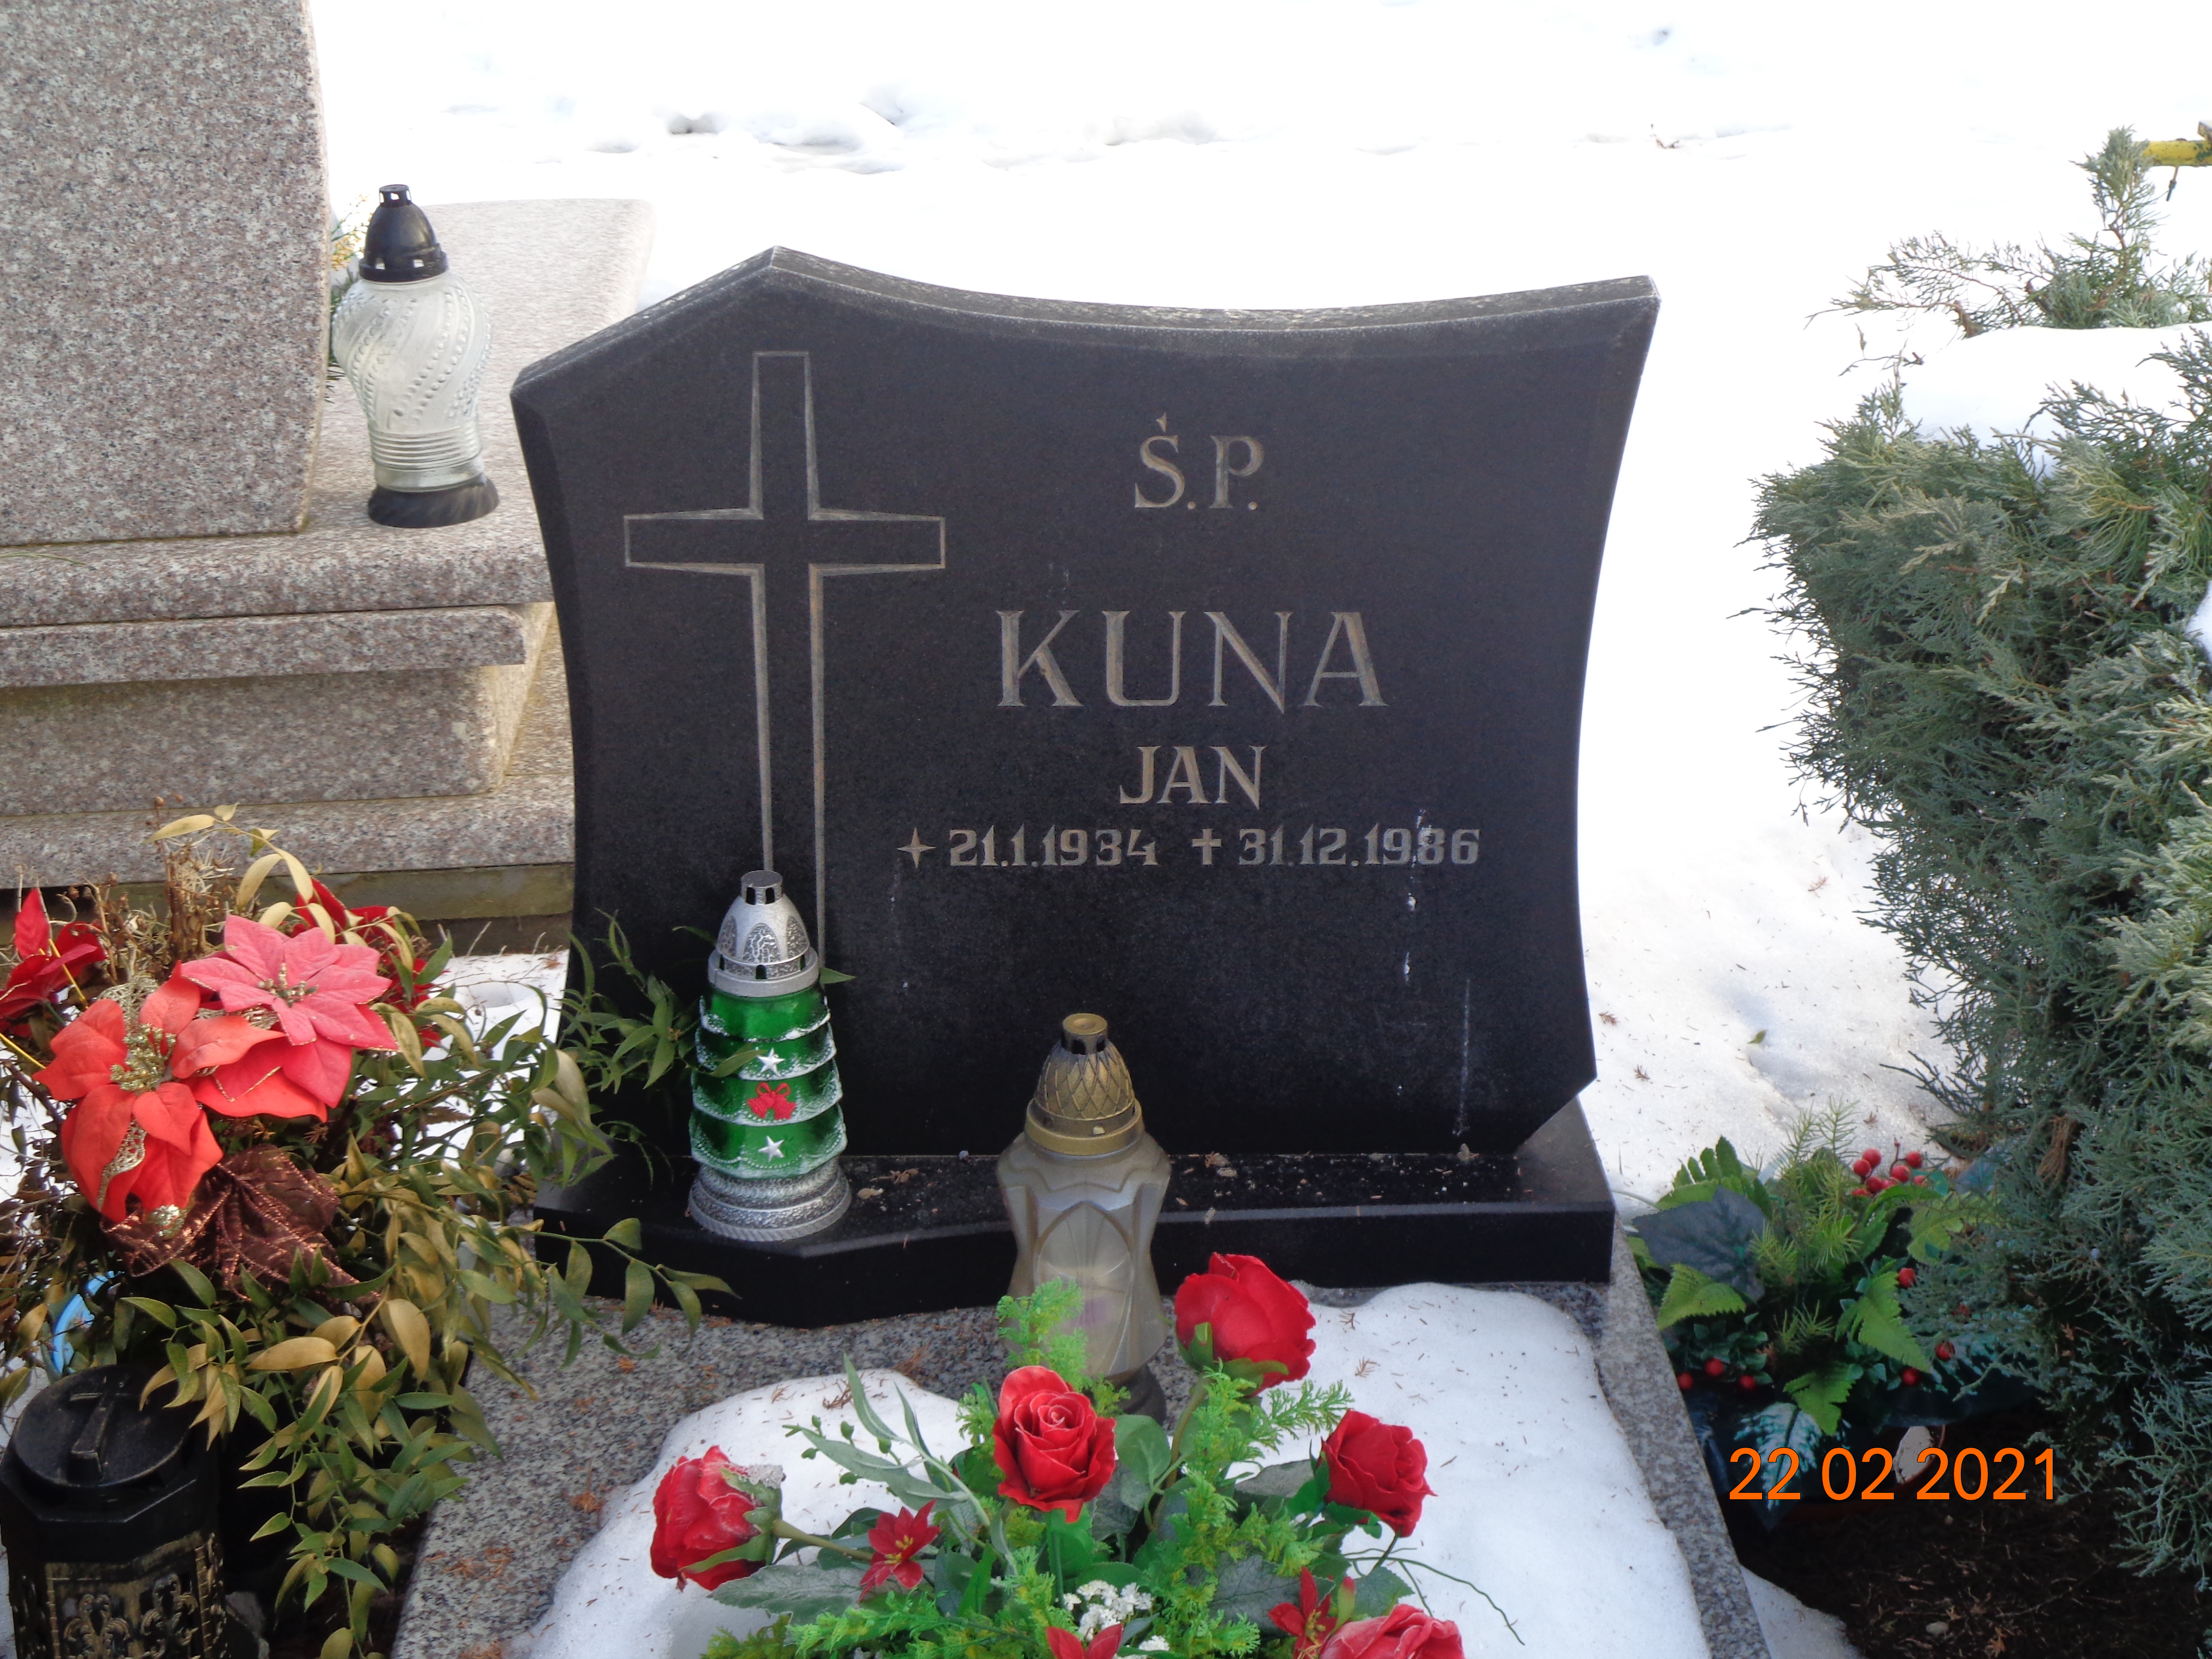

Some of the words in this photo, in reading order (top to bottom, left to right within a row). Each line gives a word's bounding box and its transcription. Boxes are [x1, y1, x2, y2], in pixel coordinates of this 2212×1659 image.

[995, 609, 1389, 713] KUNA
[1119, 745, 1267, 810] JAN
[948, 824, 1160, 867] 21.1.1934
